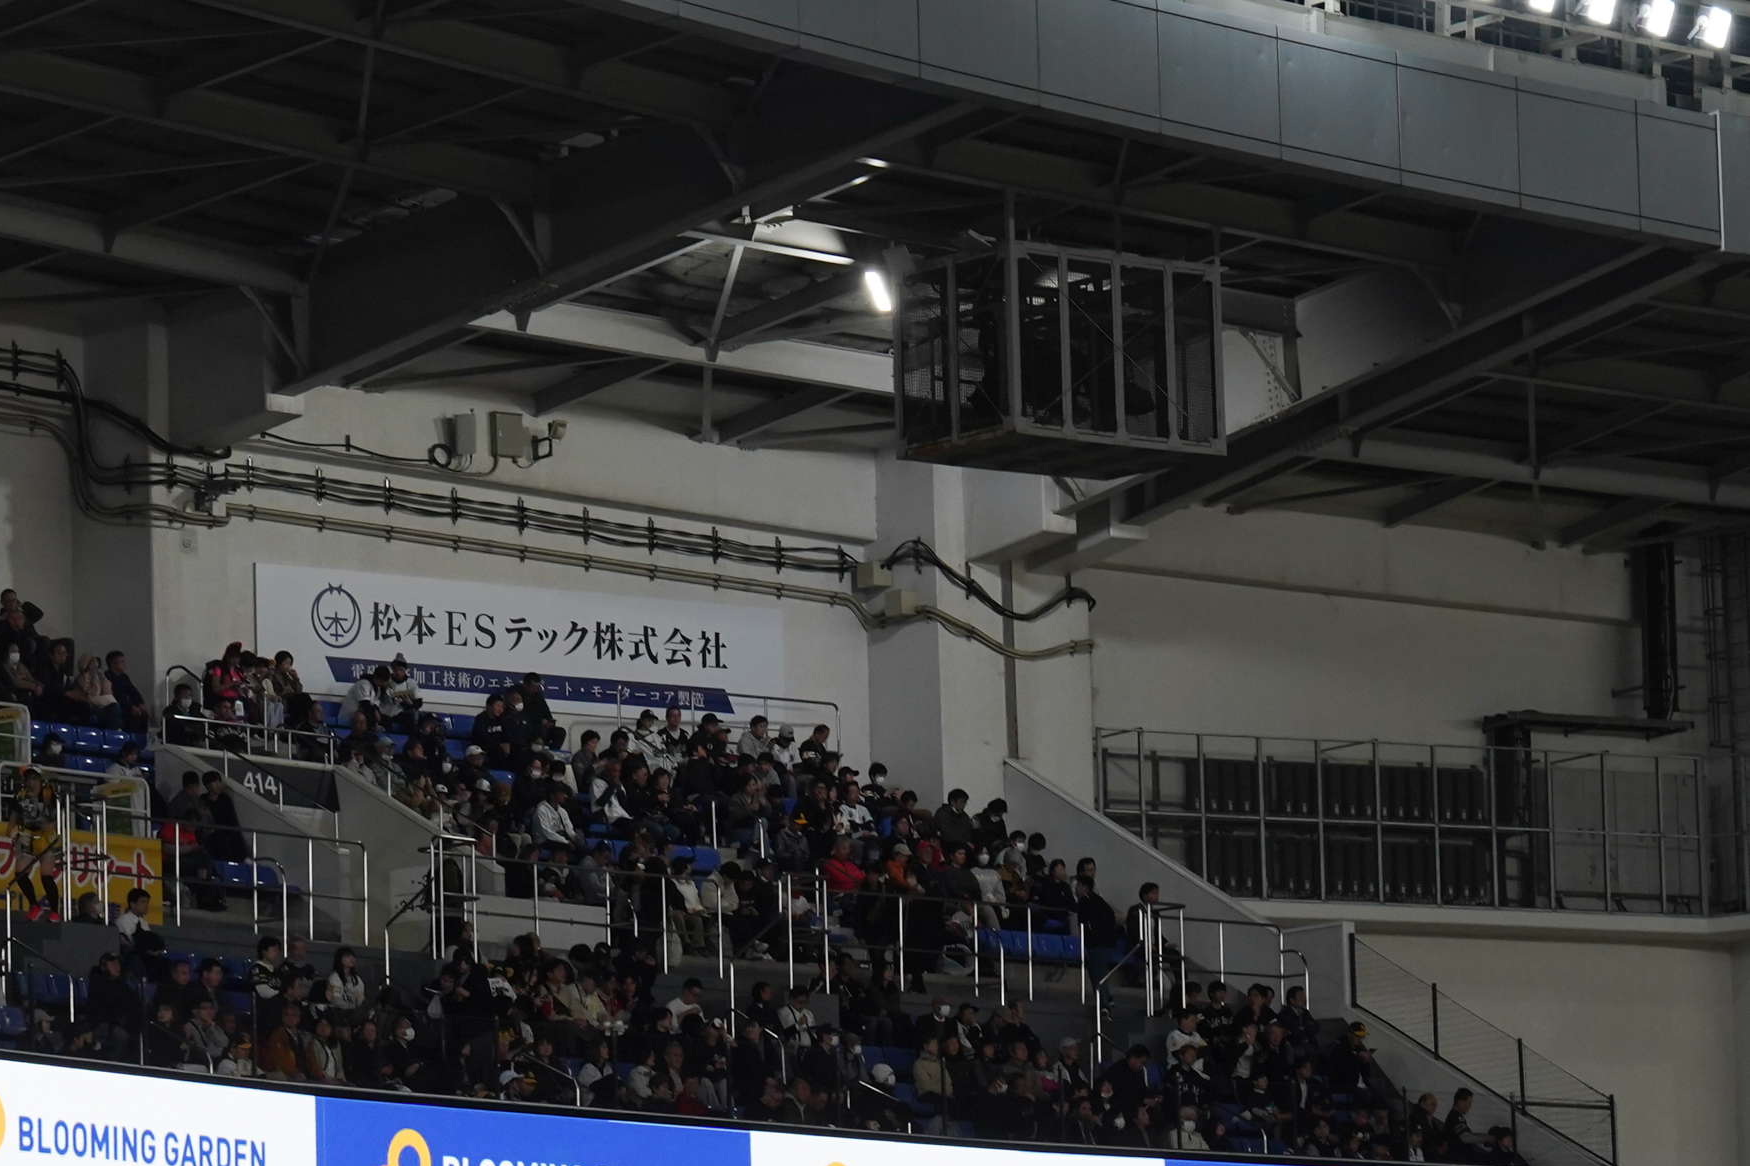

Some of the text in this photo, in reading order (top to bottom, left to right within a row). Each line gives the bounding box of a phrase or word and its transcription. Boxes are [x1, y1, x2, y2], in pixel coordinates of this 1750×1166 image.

[369, 601, 729, 670] 松本ESテック株式会社
[243, 770, 279, 796] 414
[18, 1115, 156, 1165] BLOOMING
